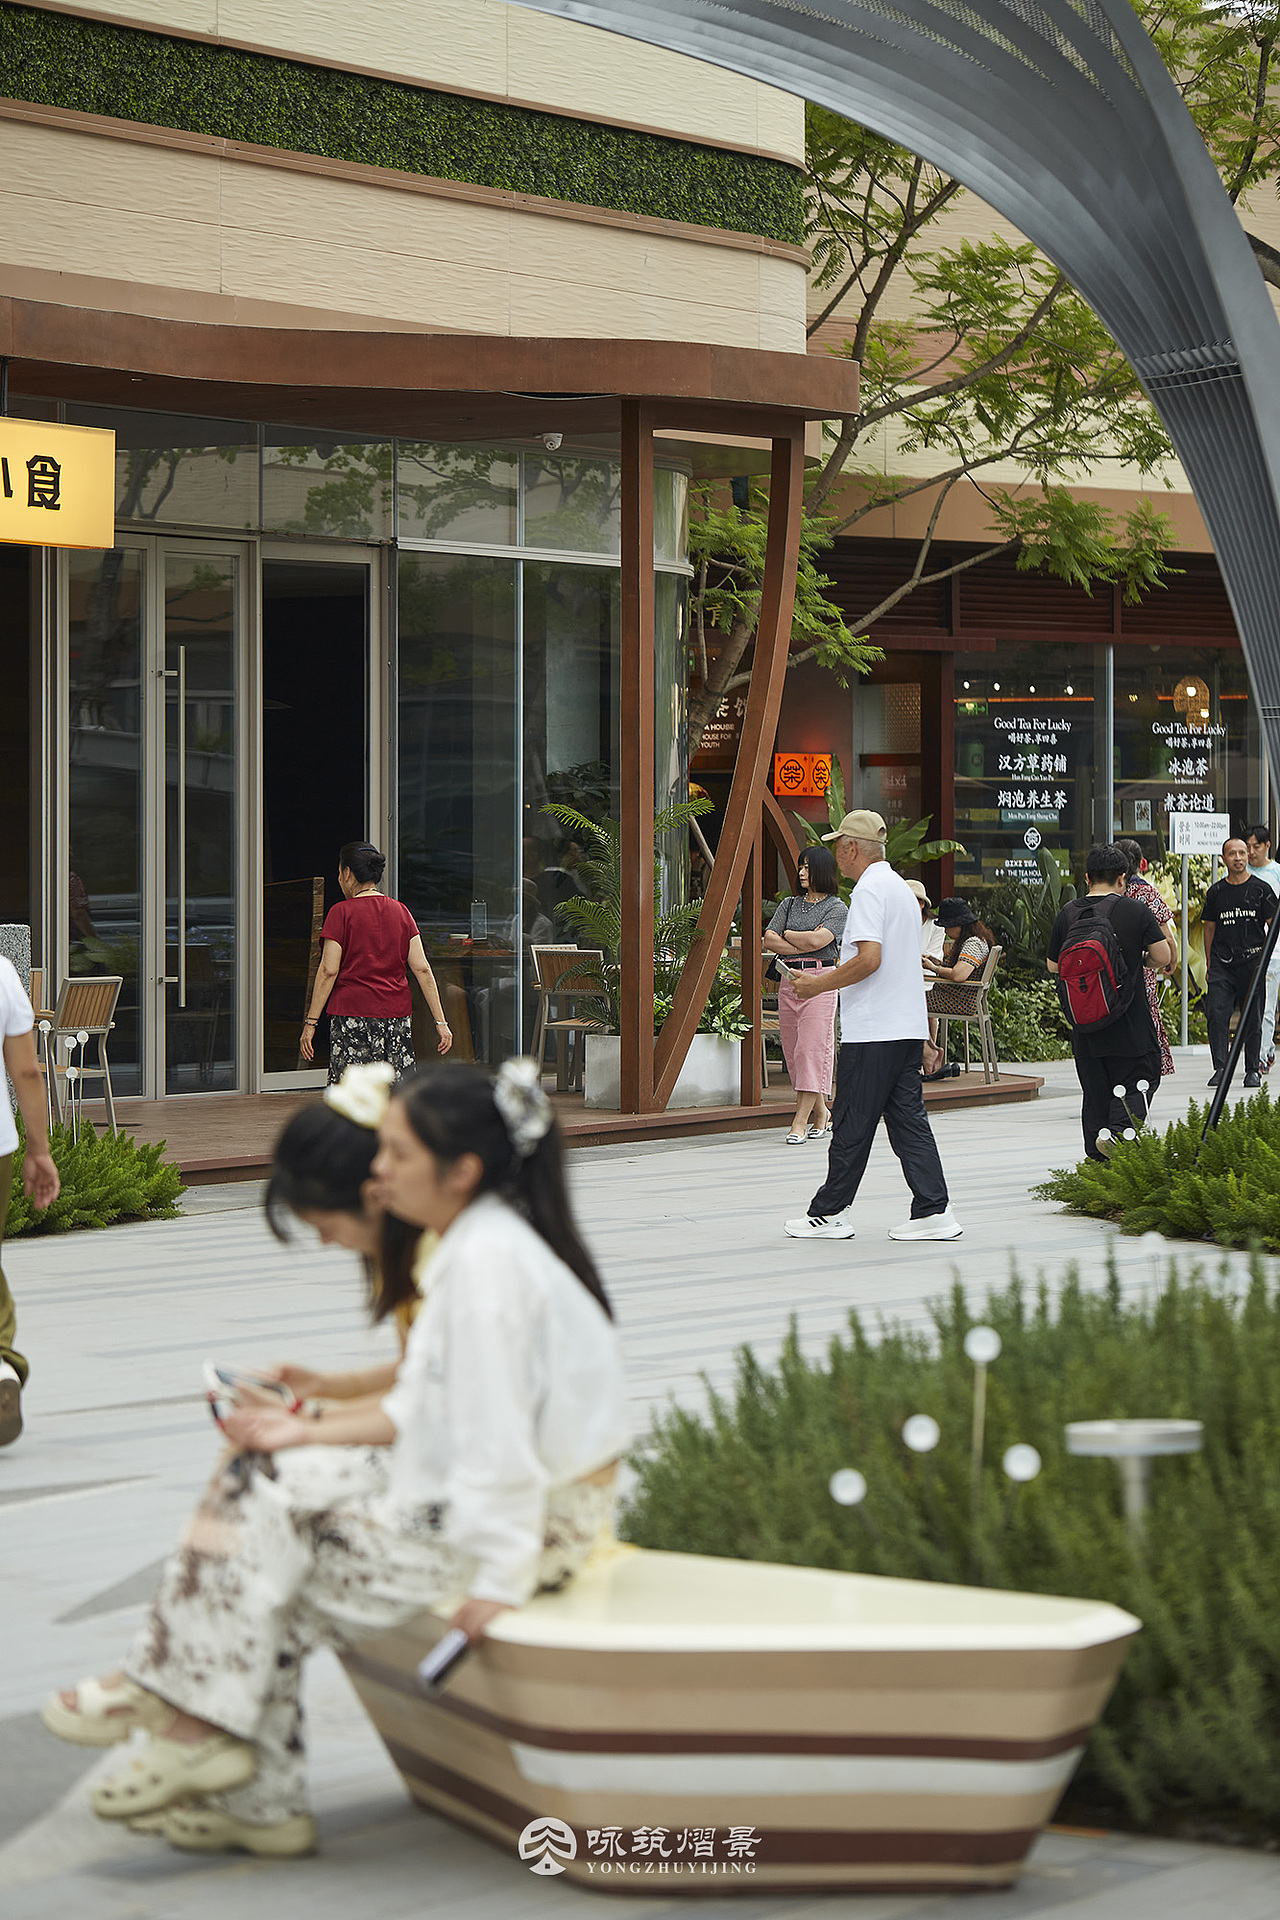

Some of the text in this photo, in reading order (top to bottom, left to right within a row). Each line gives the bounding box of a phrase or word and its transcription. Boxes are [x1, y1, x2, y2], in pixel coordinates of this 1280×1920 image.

[994, 716, 1072, 733] Good Tea For Lucky
[1152, 721, 1226, 737] Good Tea For Lucky
[998, 753, 1067, 773] 汉方草药铺
[1168, 757, 1209, 777] 冰泡茶
[997, 789, 1068, 810] 焖泡养生茶
[1163, 792, 1216, 812] 煮茶论道
